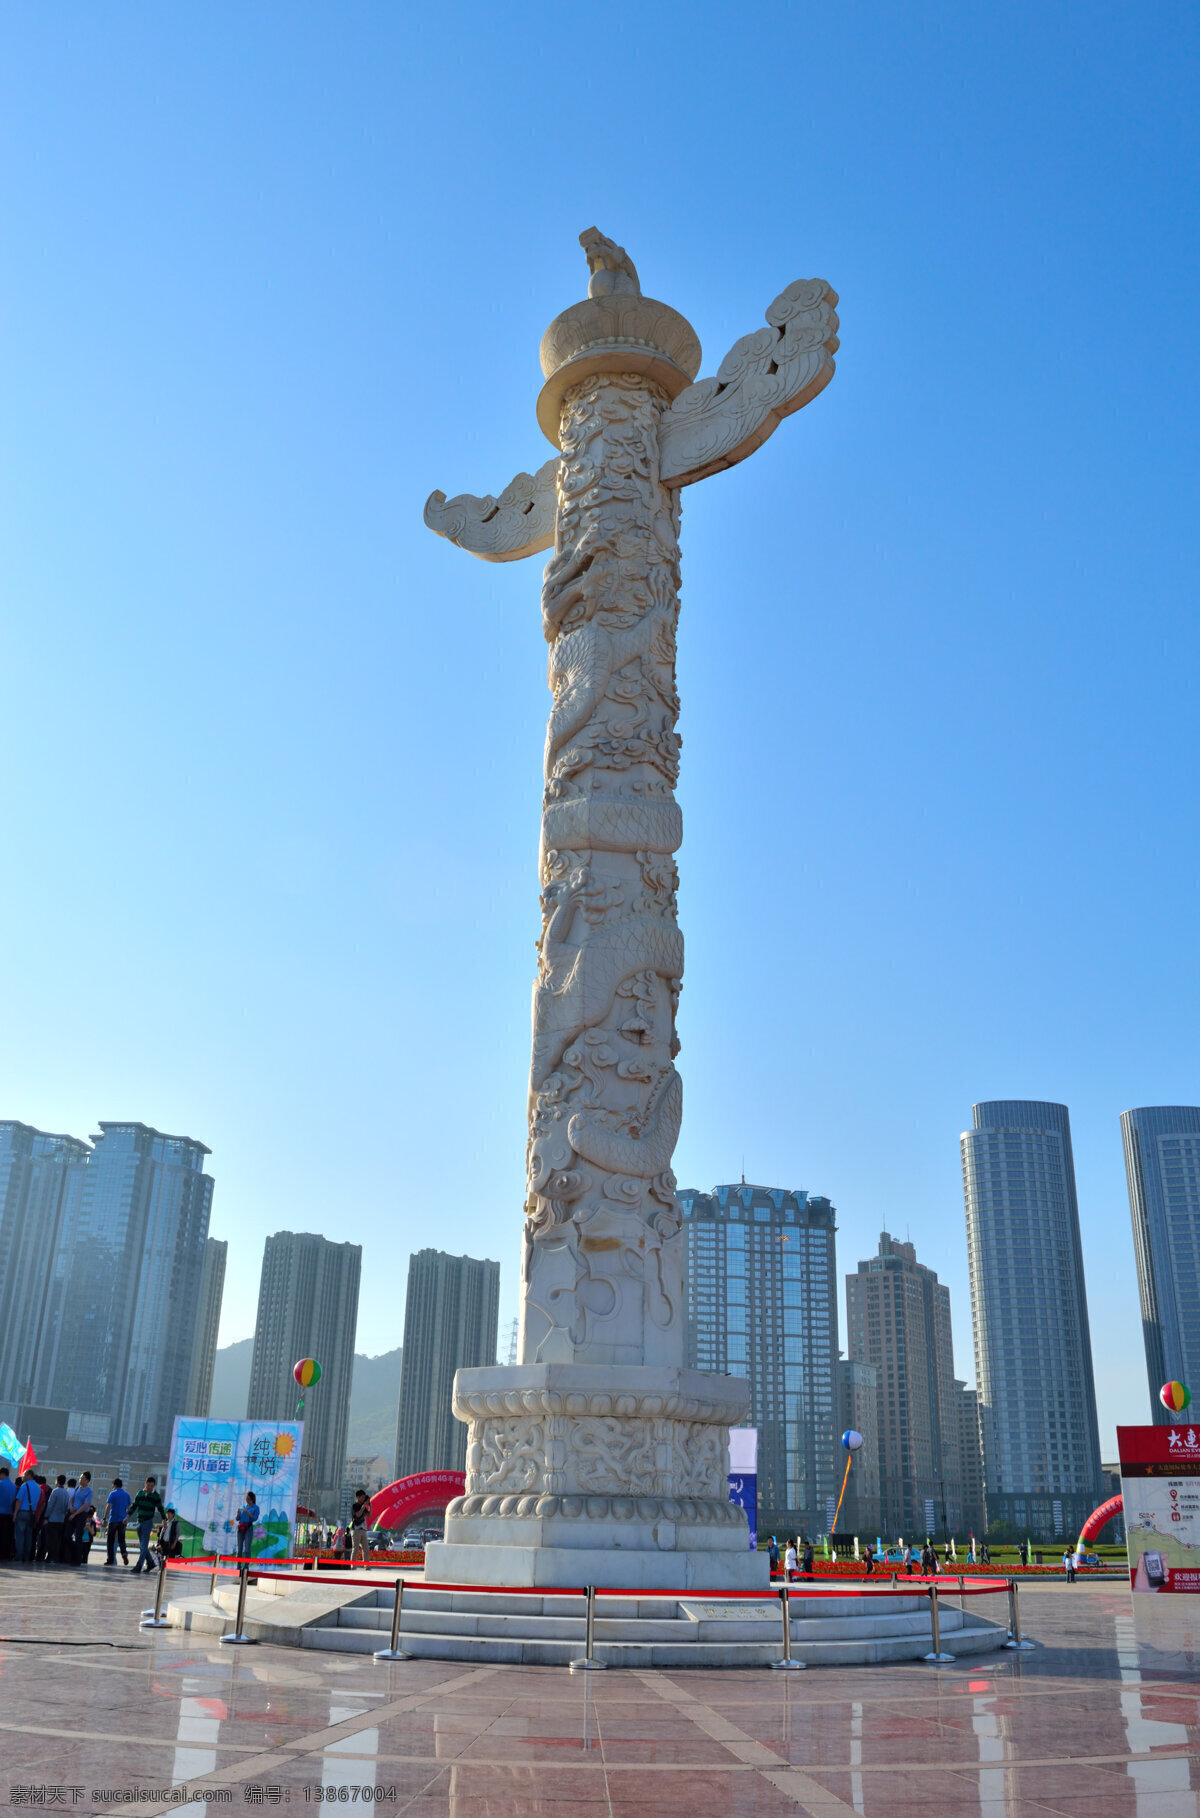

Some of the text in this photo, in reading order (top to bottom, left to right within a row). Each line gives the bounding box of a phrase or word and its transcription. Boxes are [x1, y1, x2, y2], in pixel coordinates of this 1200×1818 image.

[1168, 1428, 1200, 1448] 大連
[184, 1440, 232, 1456] 爱心传递
[182, 1457, 231, 1473] 净水童年
